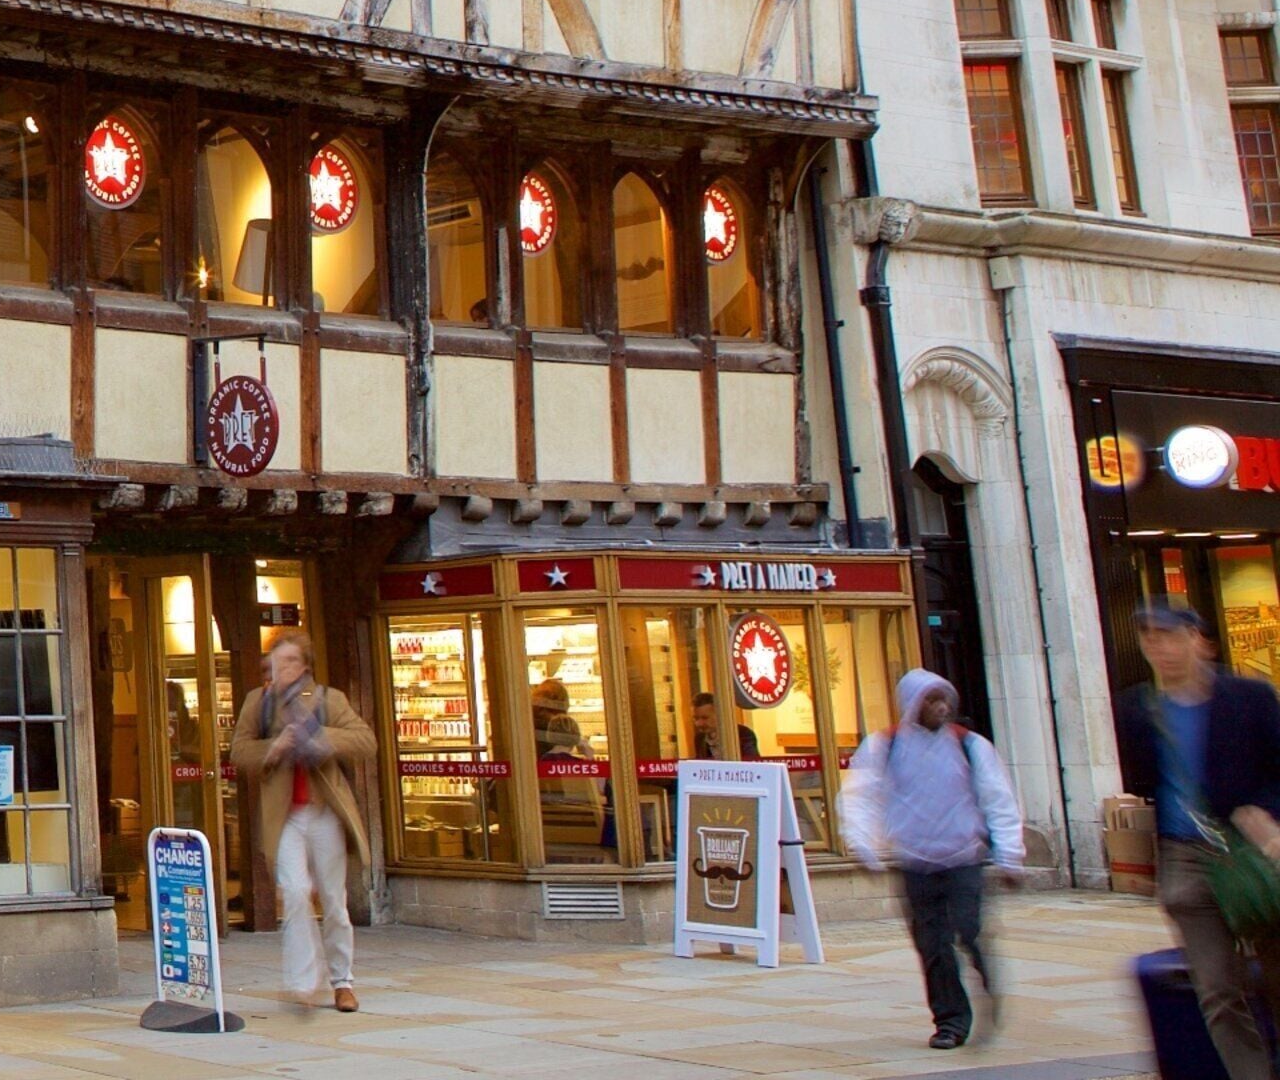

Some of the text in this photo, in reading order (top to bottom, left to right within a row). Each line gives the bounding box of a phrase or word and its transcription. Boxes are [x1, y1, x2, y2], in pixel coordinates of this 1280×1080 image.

[209, 380, 271, 425] ORGANIC COFFEE
[223, 409, 257, 446] PRET
[211, 437, 269, 474] NATURAL FOOD
[720, 561, 820, 591] PRET A MANGER
[175, 766, 237, 777] CROINTS
[402, 763, 507, 774] COOKIES TOASTIES
[547, 764, 599, 775] JUICES
[699, 768, 715, 781] PRET
[724, 770, 754, 783] MANGER
[155, 847, 202, 867] CHANGE
